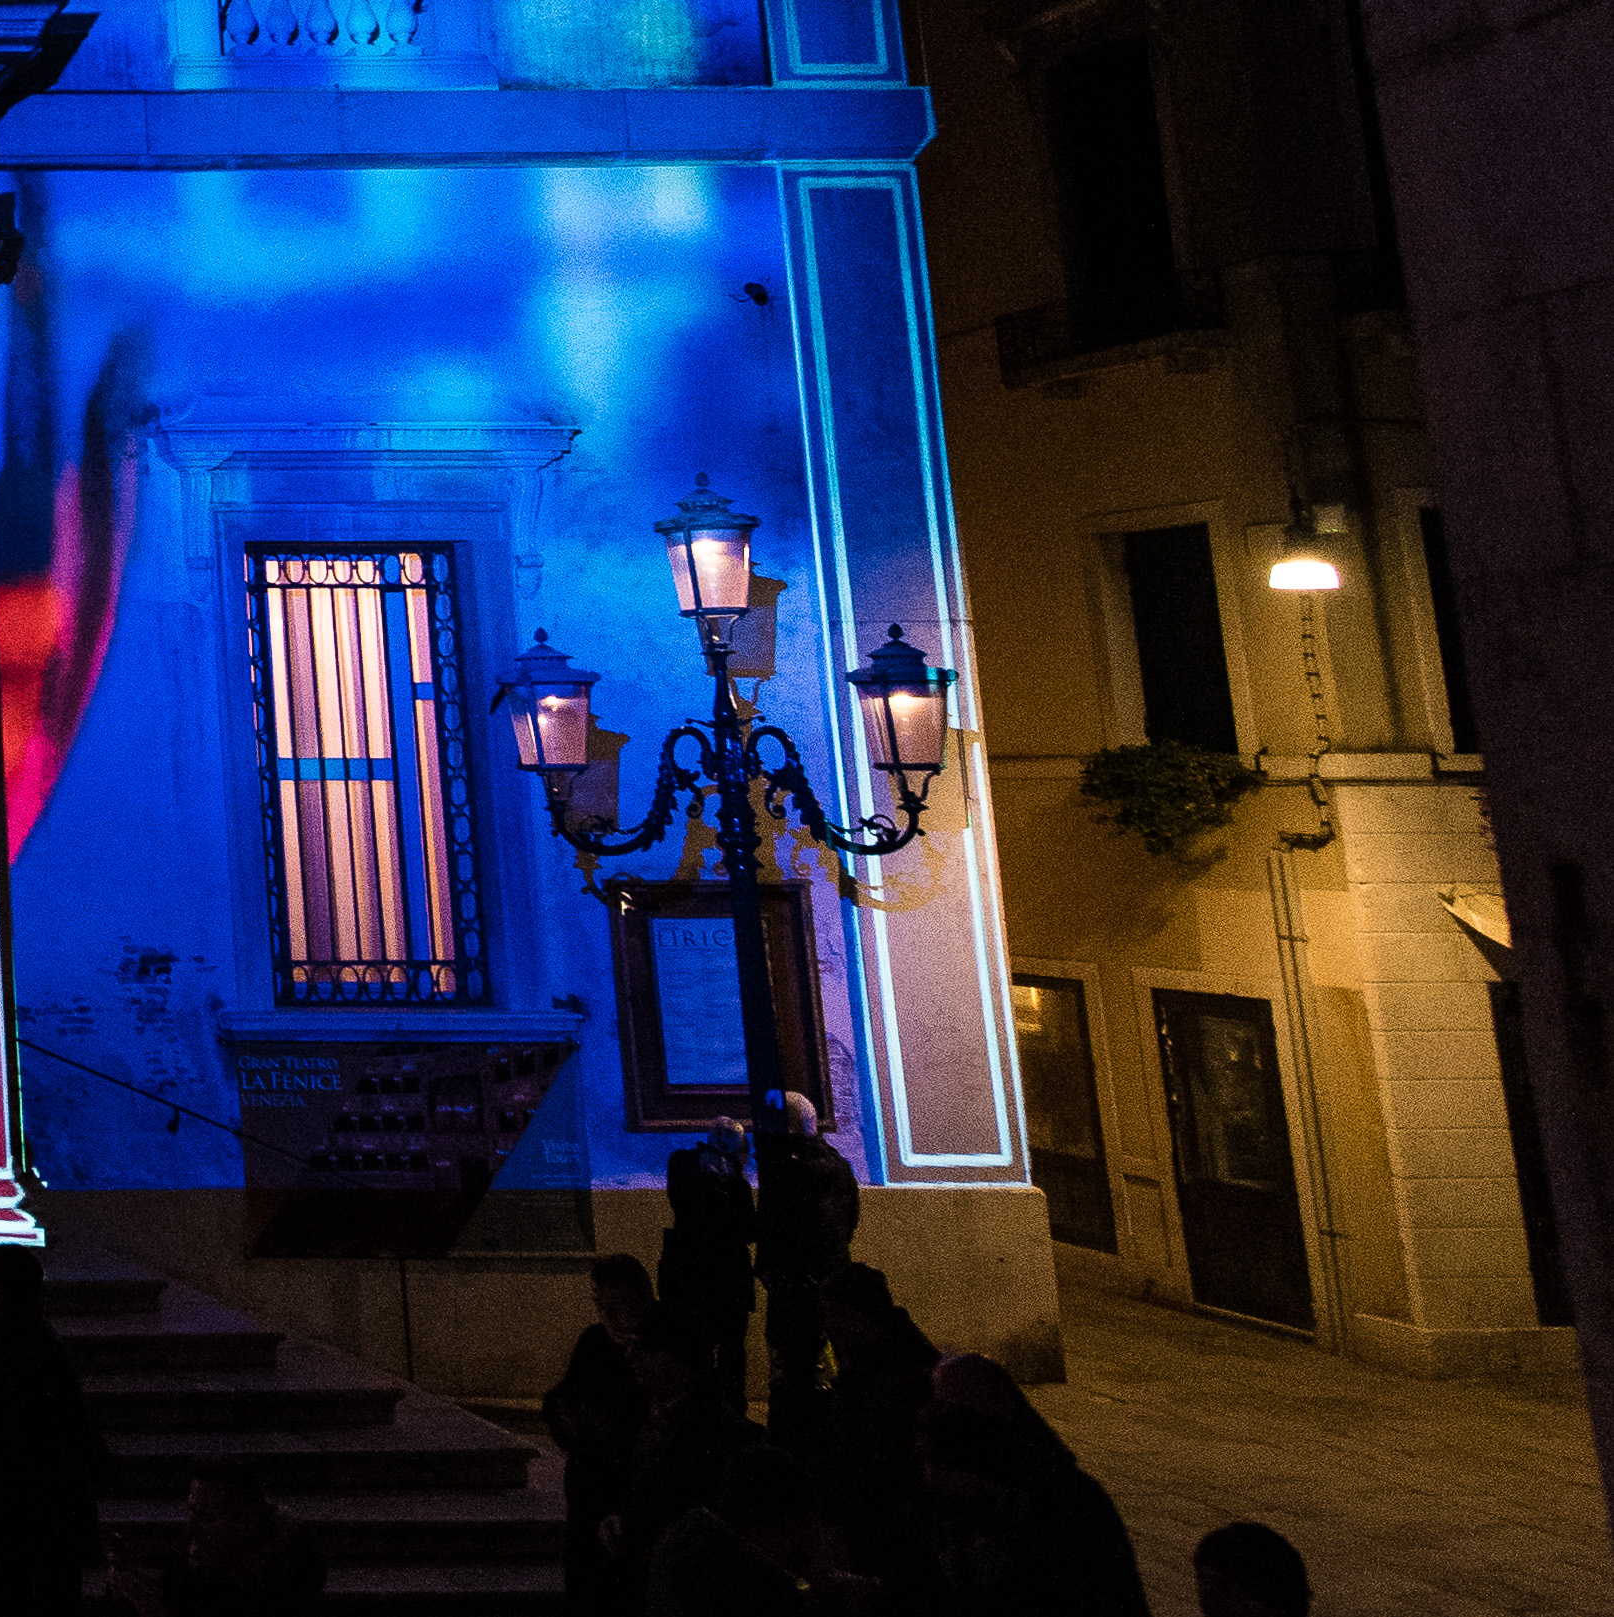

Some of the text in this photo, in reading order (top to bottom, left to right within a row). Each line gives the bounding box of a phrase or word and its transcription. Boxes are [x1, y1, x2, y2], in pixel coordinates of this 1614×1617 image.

[657, 927, 731, 947] LIRIC
[237, 1055, 338, 1070] GRAN TEATRO
[240, 1071, 343, 1091] LA FENICE
